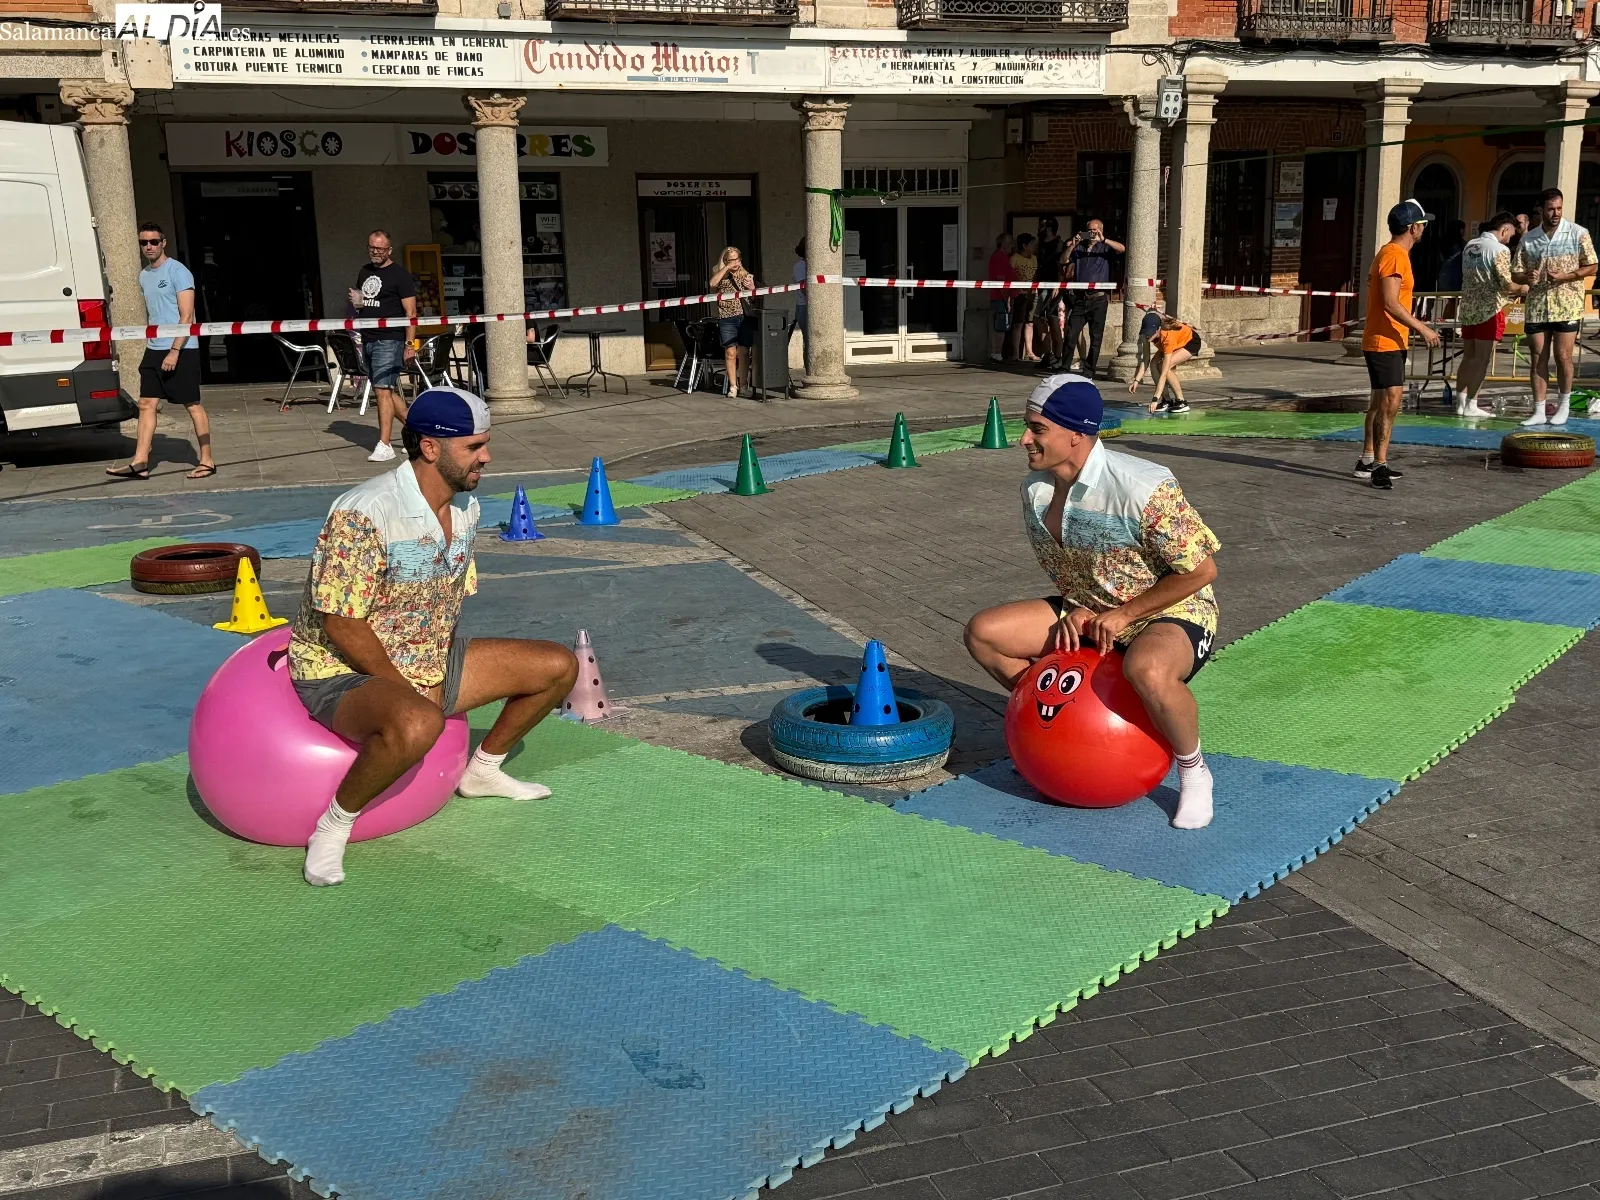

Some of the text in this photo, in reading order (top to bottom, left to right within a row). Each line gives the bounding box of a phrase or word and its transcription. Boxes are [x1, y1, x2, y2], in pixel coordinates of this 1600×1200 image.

[279, 32, 340, 44] METALICAS
[370, 34, 435, 46] CERRAJERIA
[442, 36, 456, 47] EN
[193, 46, 345, 59] CARPINTERIA DE ALUMINIO
[371, 49, 428, 61] MAMPARAS
[435, 51, 449, 62] DE
[925, 48, 953, 58] VENTA
[958, 48, 964, 58] Y
[194, 61, 343, 74] ROTURA PUENTE TERMICO
[372, 64, 484, 77] CERCADO DE FINCAS
[890, 61, 955, 71] HERRAMIENTAS
[972, 62, 978, 71] Y
[912, 75, 1024, 84] PARA LA CONSTRUCCION
[224, 129, 343, 158] KIOSCO
[407, 130, 596, 158] DOSRES
[653, 189, 702, 197] vending
